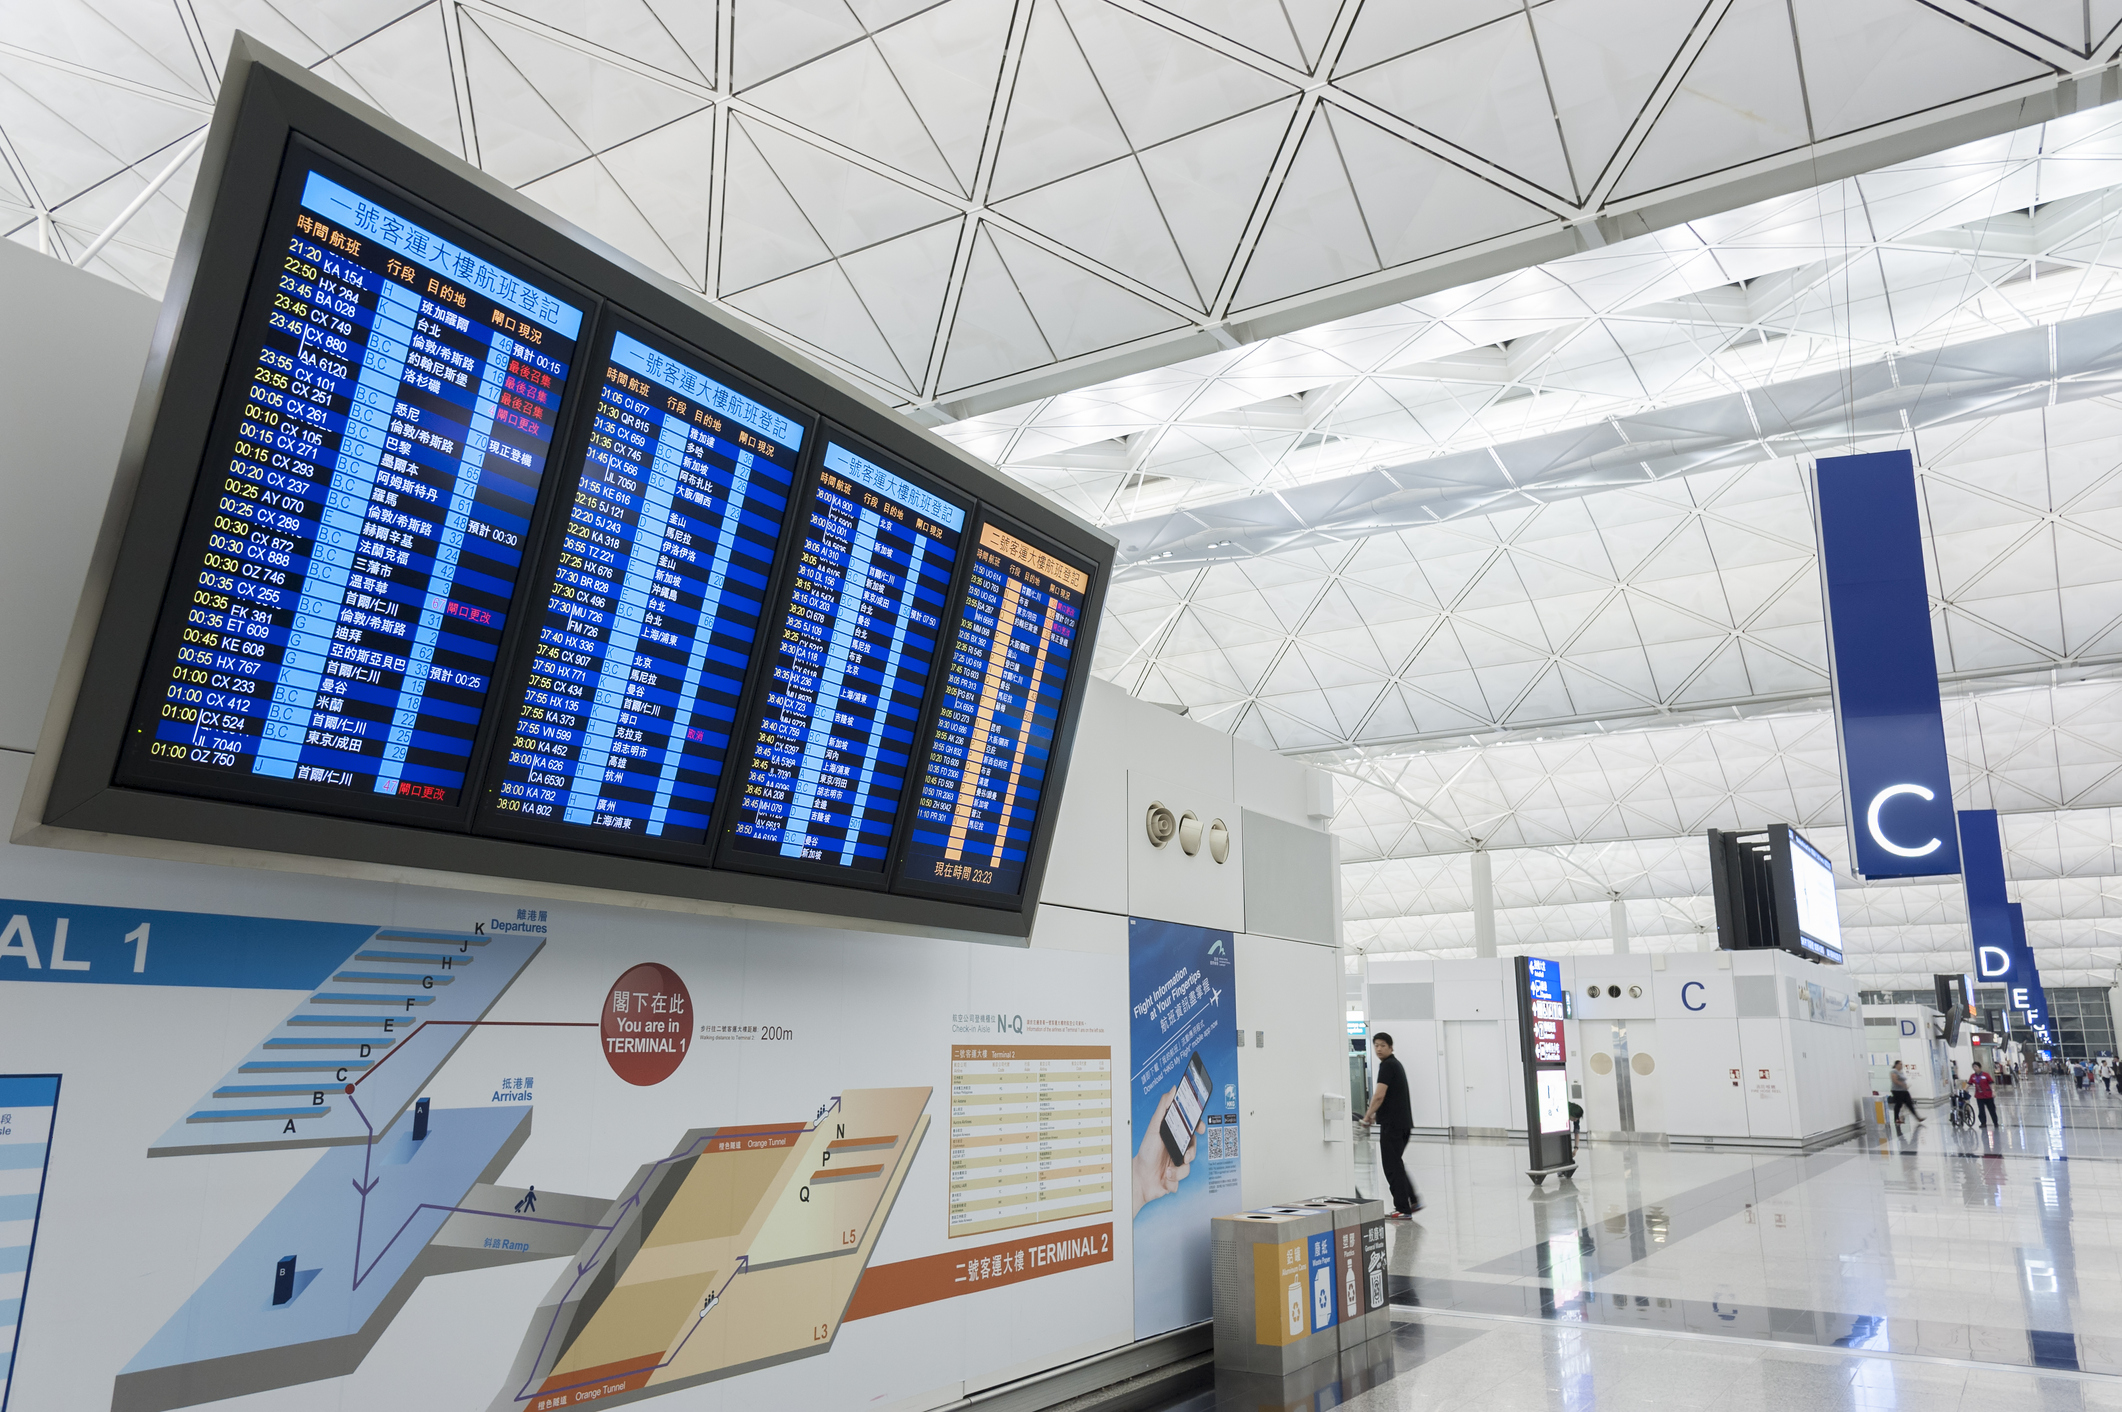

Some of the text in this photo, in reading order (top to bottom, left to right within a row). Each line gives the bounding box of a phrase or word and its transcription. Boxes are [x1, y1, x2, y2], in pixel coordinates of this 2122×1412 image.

[329, 197, 560, 325] 一號客運大樓航班登記
[296, 214, 330, 242] 時間
[328, 230, 362, 257] 航班
[386, 258, 416, 284] 行段
[427, 277, 467, 308] 目的地
[517, 322, 543, 345] 現況
[278, 274, 313, 299] 23:45
[314, 290, 332, 309] BA
[334, 299, 356, 318] 028
[373, 318, 383, 330] J
[412, 333, 475, 372] 倫敦/希斯路
[492, 370, 505, 385] 16
[629, 350, 788, 440] 一號客運大樓航班登記
[601, 386, 754, 466] 01:05 CI 677 F 雅加達 36
[234, 440, 518, 547] 00:15 CX 293 B,C 羅馬 48 預計 00:30
[837, 456, 954, 524] 一號客運大樓航班登記
[224, 478, 459, 563] 00:25 AY 070 E 赫爾辛基 24
[989, 532, 1081, 588] 二號客運大樓航班登記
[791, 589, 809, 604] 08:15
[818, 600, 831, 612] 203
[188, 609, 481, 689] 00:35 ET 609 G 亞的斯亞貝巴 33 預計 00:25
[524, 689, 549, 705] 07:55
[549, 695, 564, 708] HX
[564, 699, 580, 712] 135
[590, 706, 600, 720] K
[618, 711, 638, 726] 海口
[1867, 783, 1942, 857] C
[933, 861, 993, 885] 現在時間 23:23
[516, 908, 548, 922] 離港層
[474, 922, 486, 936] K
[490, 918, 548, 934] Departures
[0, 914, 151, 973] AL 1
[459, 940, 468, 953] J
[441, 956, 453, 970] H
[1979, 946, 2011, 977] D
[422, 975, 434, 989] G
[1133, 966, 1188, 1019] Flight Information
[1150, 969, 1201, 1021] at Your Fingertips
[1680, 981, 1707, 1011] C
[2012, 988, 2030, 1009] E
[405, 998, 416, 1012] F
[612, 990, 685, 1014] 閣下在此
[2027, 1008, 2039, 1024] F
[383, 1018, 395, 1032] E
[617, 1017, 680, 1033] You are in
[952, 1024, 991, 1033] Check-in Aisle
[997, 1014, 1023, 1035] N-Q
[1900, 1020, 1917, 1036] D
[761, 1025, 793, 1041] 200m
[359, 1044, 372, 1058] D
[606, 1037, 687, 1053] TERMINAL 1
[954, 1049, 988, 1059] 二號客運大樓
[992, 1050, 1016, 1059] Terminal 2
[1143, 1072, 1164, 1095] Download
[1191, 1033, 1204, 1049] mobile
[1203, 1027, 1211, 1038] app
[1210, 1020, 1219, 1031] now
[336, 1067, 348, 1082] C
[502, 1076, 534, 1090] 抵港層
[312, 1091, 325, 1106] B
[491, 1090, 533, 1102] Arrivals
[417, 1106, 423, 1114] A
[282, 1118, 297, 1134] A
[836, 1123, 845, 1139] N
[718, 1140, 742, 1150] 橙色隧道
[747, 1137, 787, 1149] Orange Tunnel
[822, 1151, 831, 1167] P
[799, 1185, 810, 1203] Q
[483, 1237, 502, 1249] 斜路
[842, 1228, 857, 1246] L5
[502, 1238, 530, 1253] Ramp
[1028, 1233, 1109, 1268] TERMINAL 2
[1364, 1242, 1385, 1252] General Waste
[1312, 1256, 1331, 1267] Waste Paper
[1344, 1250, 1355, 1258] Plastics
[279, 1268, 286, 1276] B
[954, 1249, 1025, 1283] 二號客運大樓
[1282, 1263, 1307, 1276] Aluminum Cans
[813, 1323, 828, 1341] L3
[575, 1381, 626, 1401] Orange Tunnel
[537, 1395, 568, 1411] 橙色隧道
